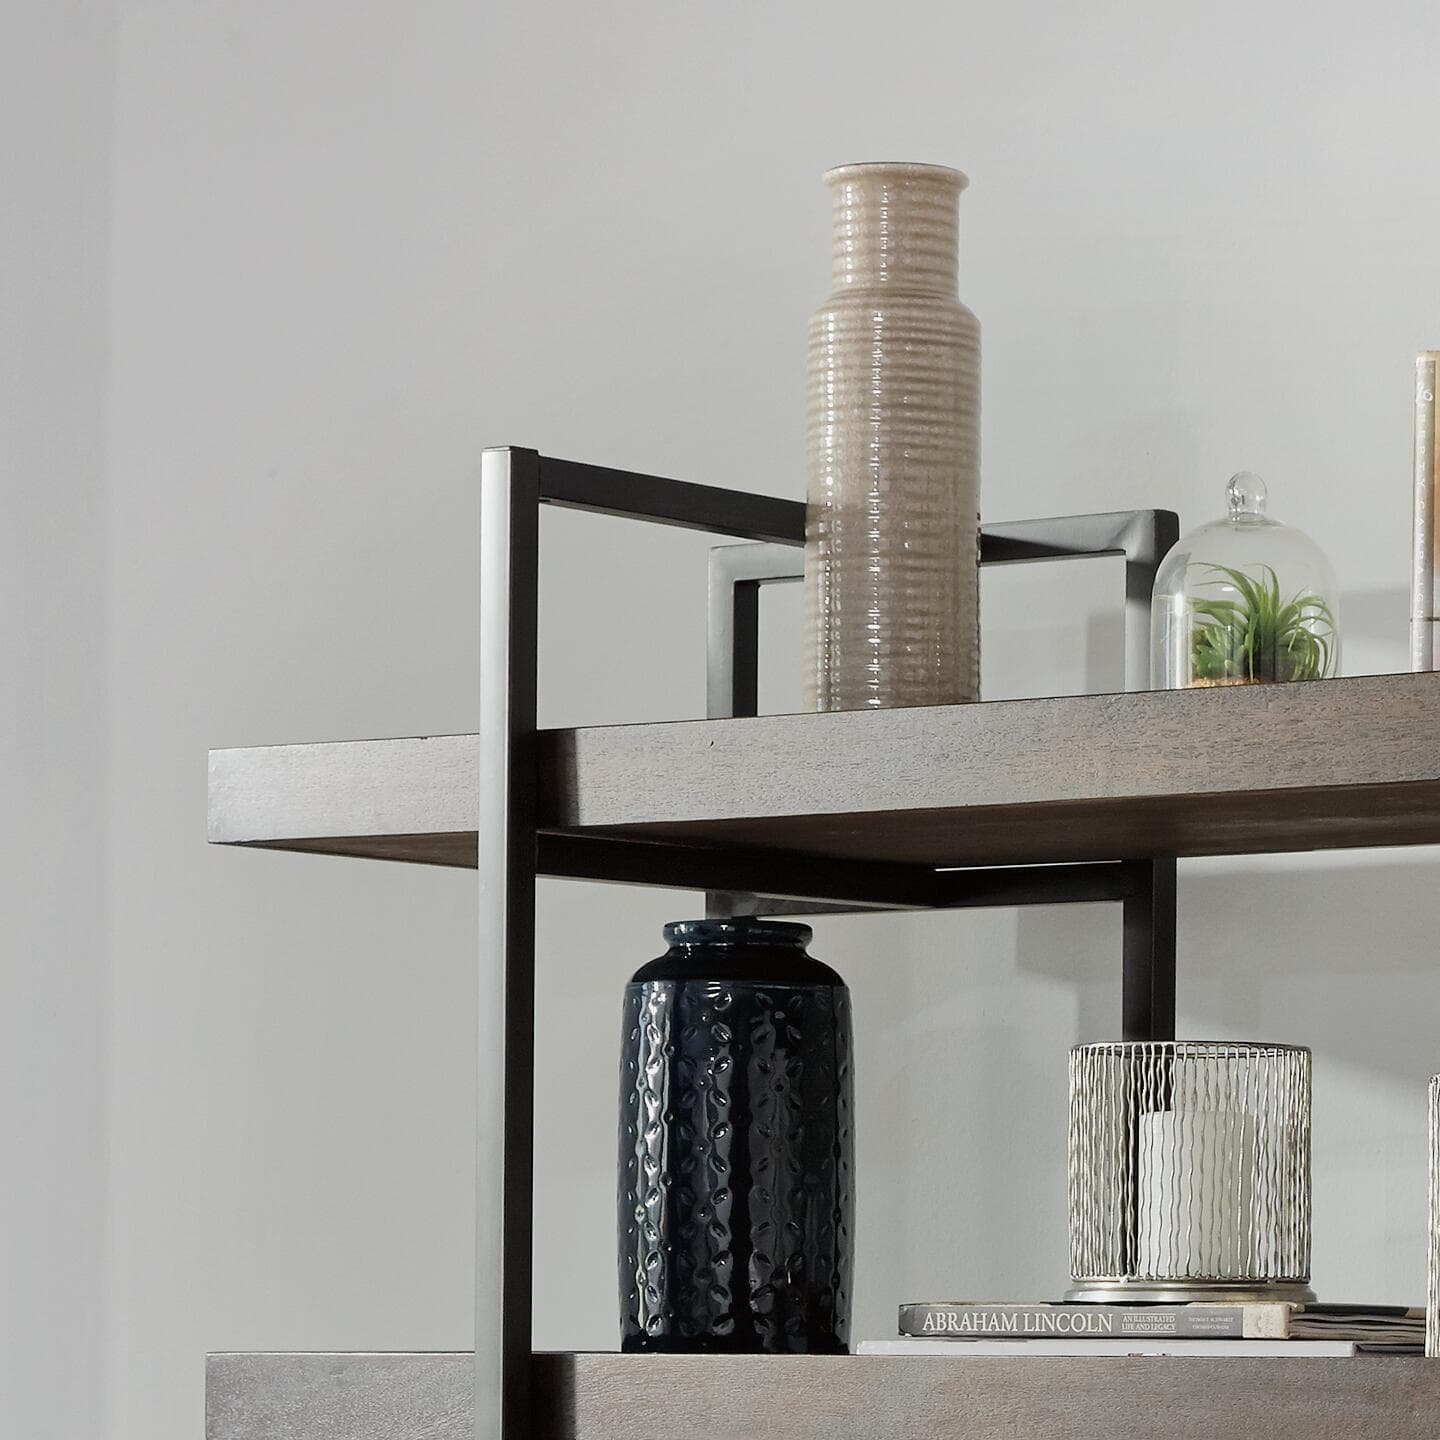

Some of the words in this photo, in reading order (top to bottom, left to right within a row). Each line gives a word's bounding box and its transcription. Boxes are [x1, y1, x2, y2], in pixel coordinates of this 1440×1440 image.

[922, 1312, 1021, 1332] ABRAHAM
[1023, 1312, 1113, 1333] LINCOLN
[1151, 1323, 1176, 1331] LEGACY
